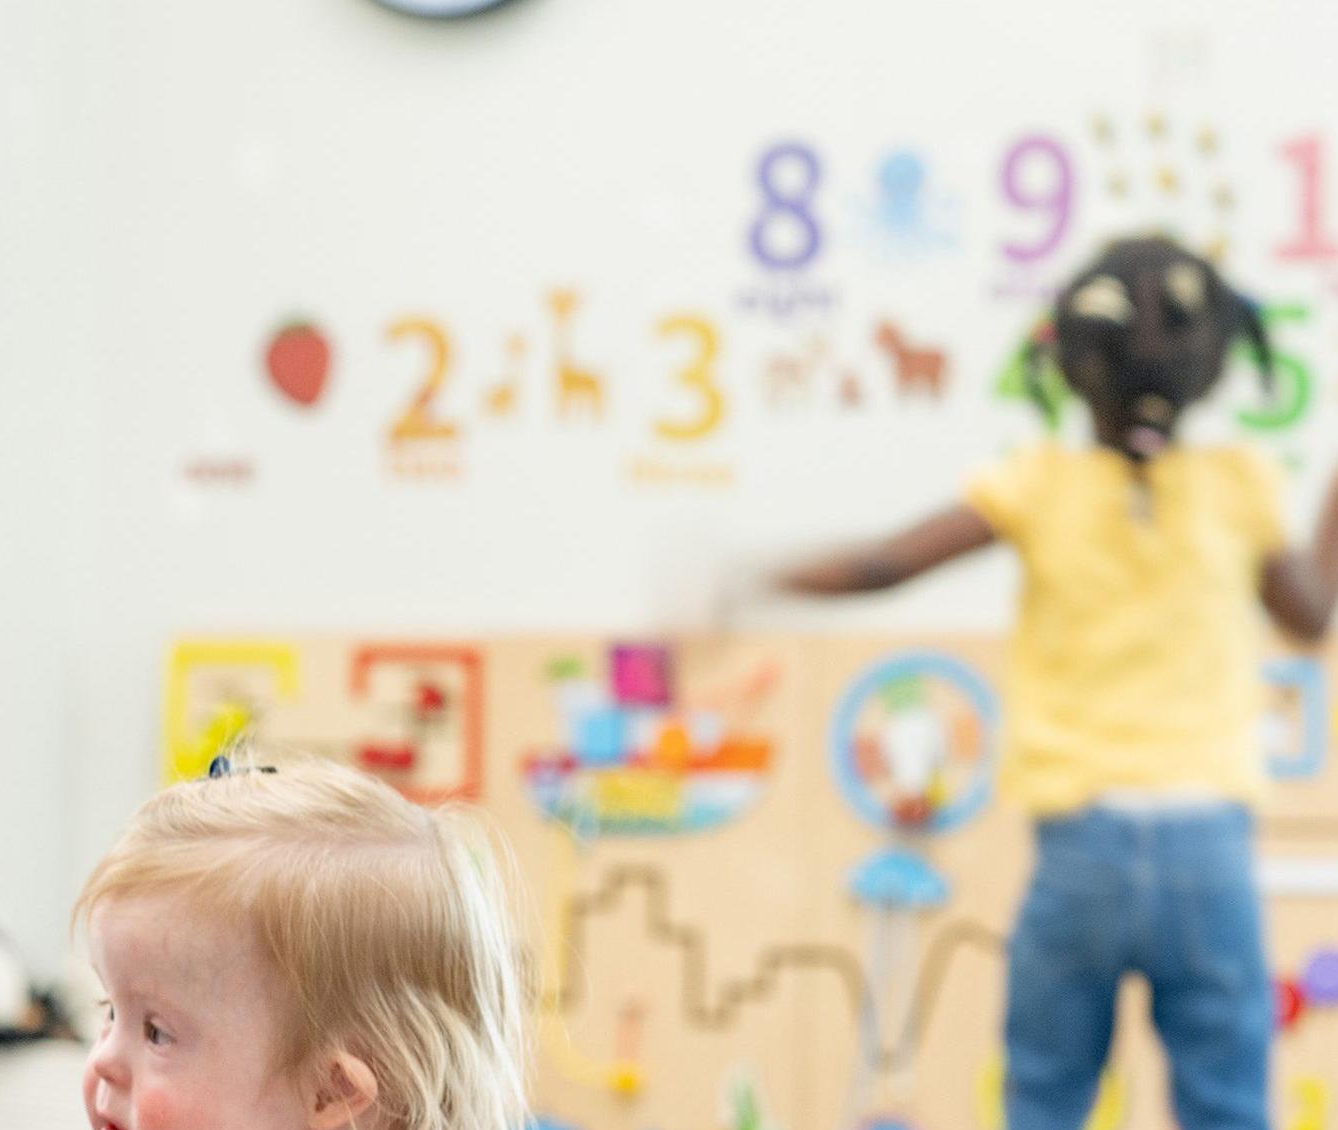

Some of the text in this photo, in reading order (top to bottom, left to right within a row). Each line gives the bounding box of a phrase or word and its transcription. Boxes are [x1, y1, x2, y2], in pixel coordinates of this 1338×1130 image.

[742, 138, 829, 270] 8
[997, 132, 1077, 266] 9
[384, 315, 462, 440] 2
[651, 311, 730, 444] 3
[1235, 304, 1313, 433] 5
